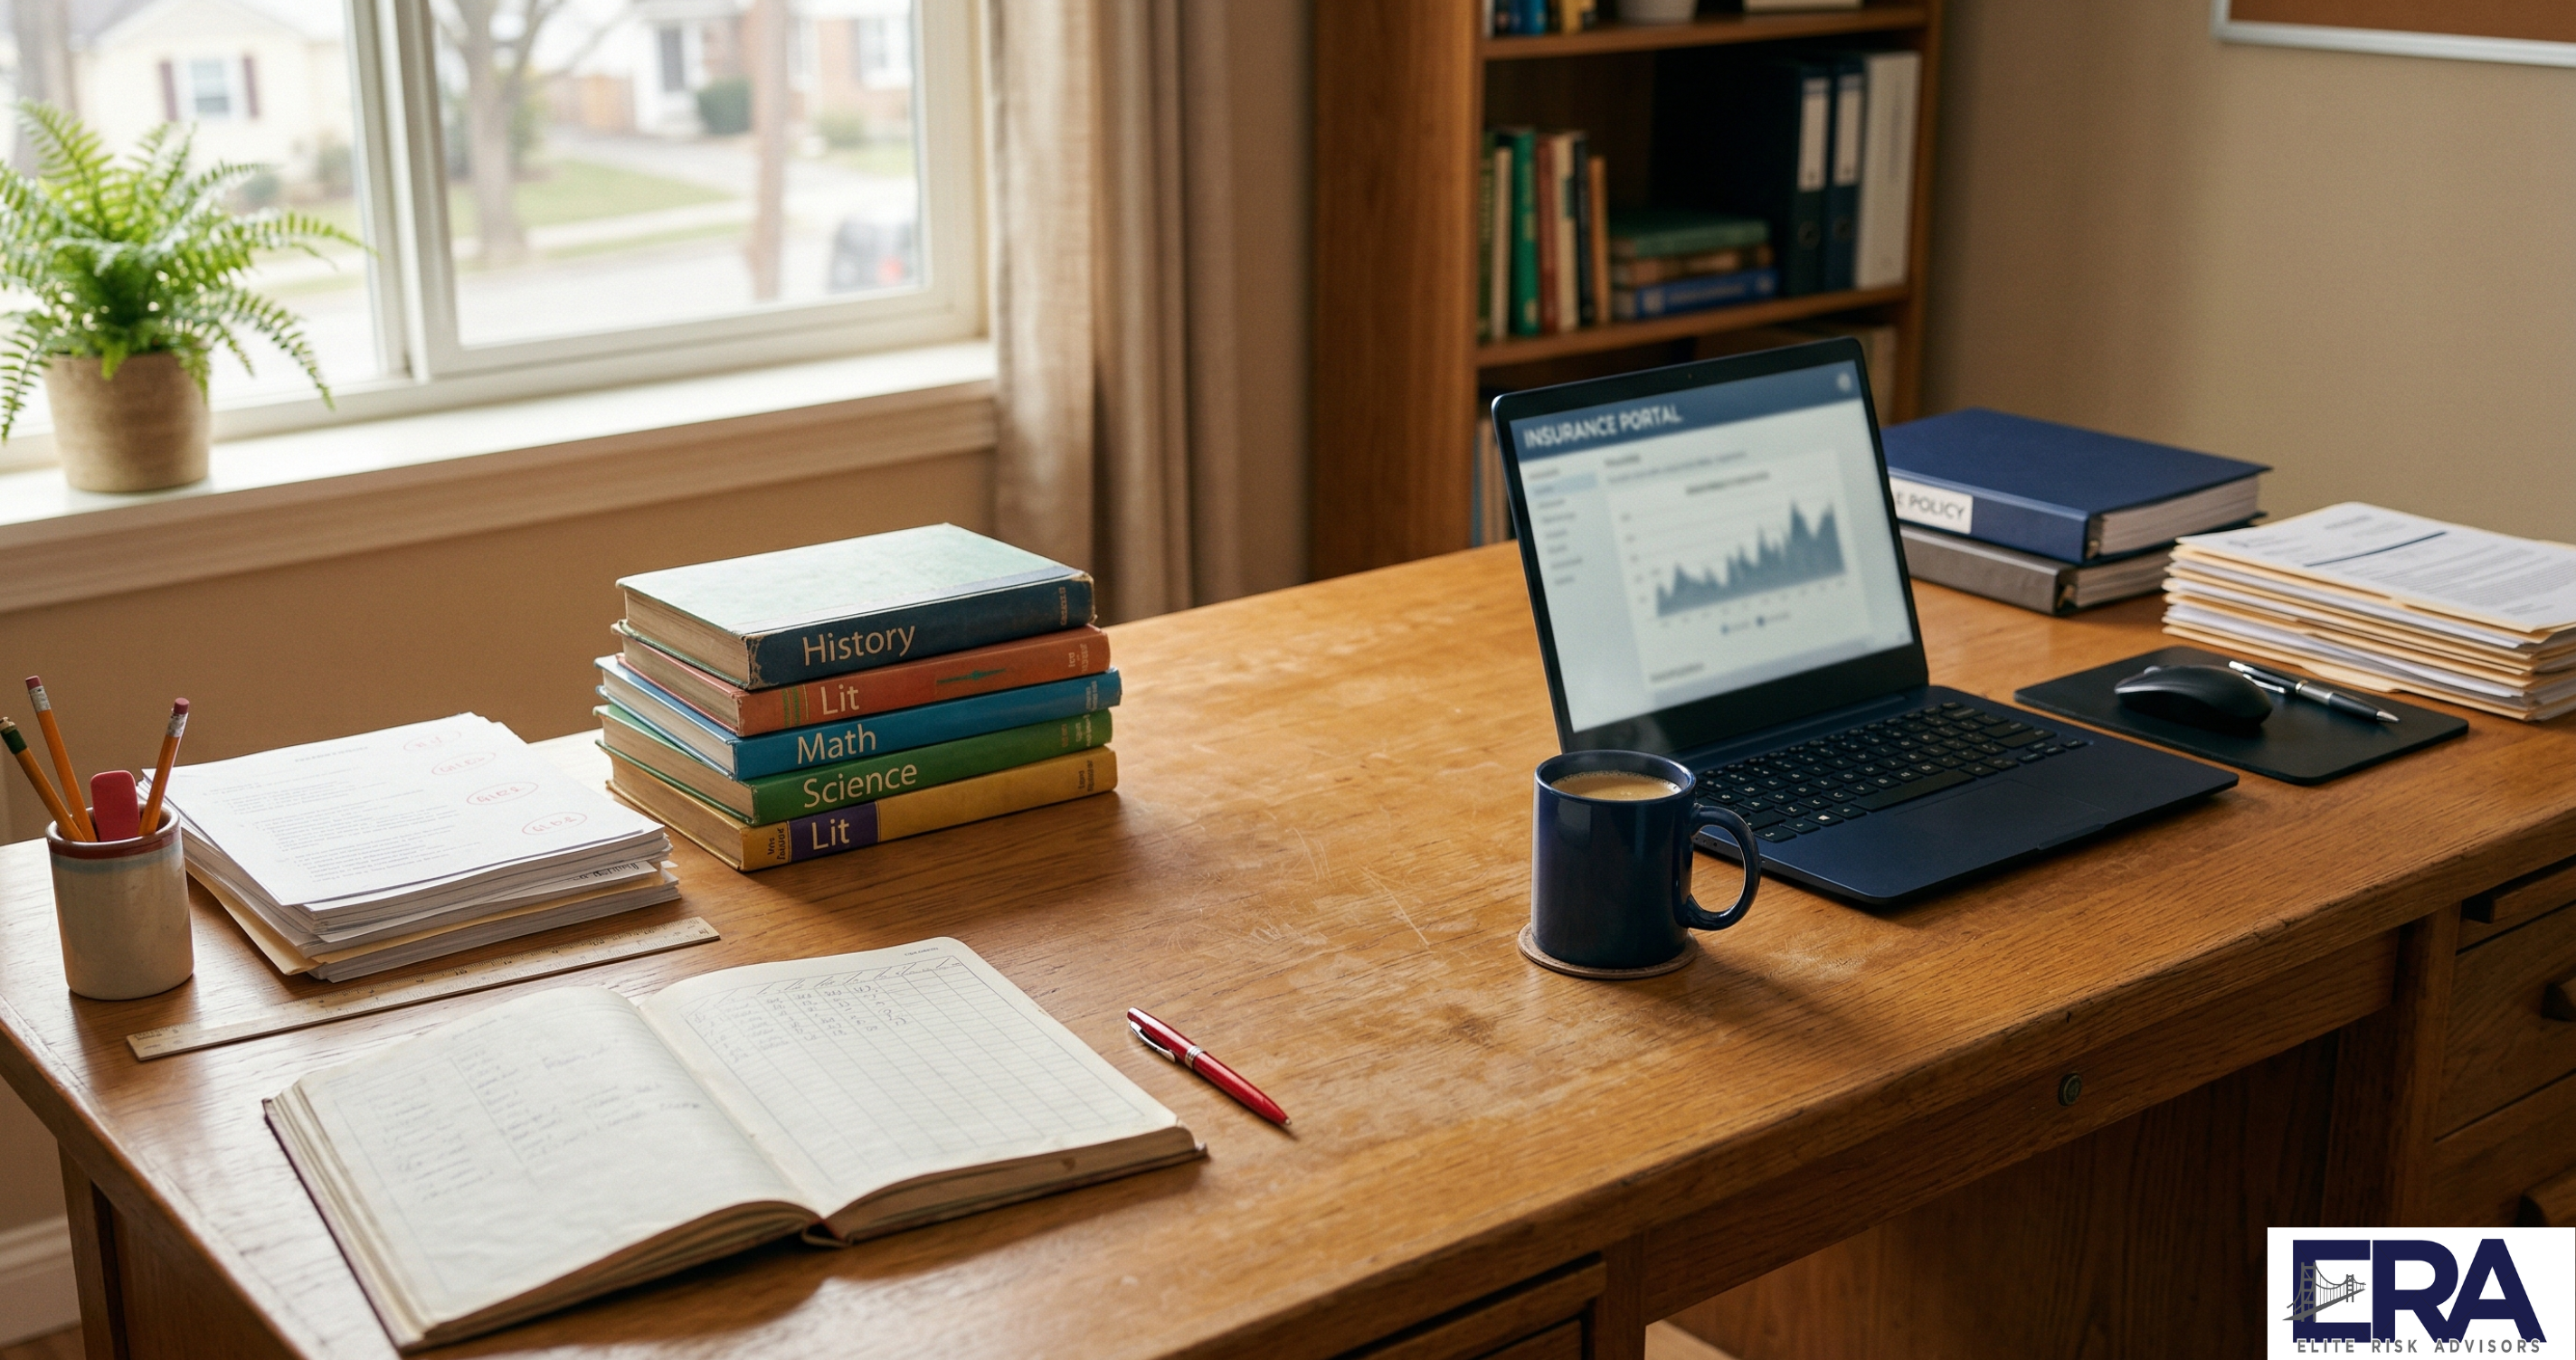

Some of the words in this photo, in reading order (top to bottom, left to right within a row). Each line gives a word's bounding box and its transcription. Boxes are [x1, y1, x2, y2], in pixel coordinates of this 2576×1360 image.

[1523, 413, 1617, 449] INSURANCE
[1618, 404, 1684, 432] PORTAL
[1908, 494, 1965, 520] POLICY
[802, 625, 915, 666] History
[820, 684, 859, 715] Lit
[798, 723, 876, 765] Math
[803, 764, 917, 808] Science
[811, 818, 850, 851] Lit
